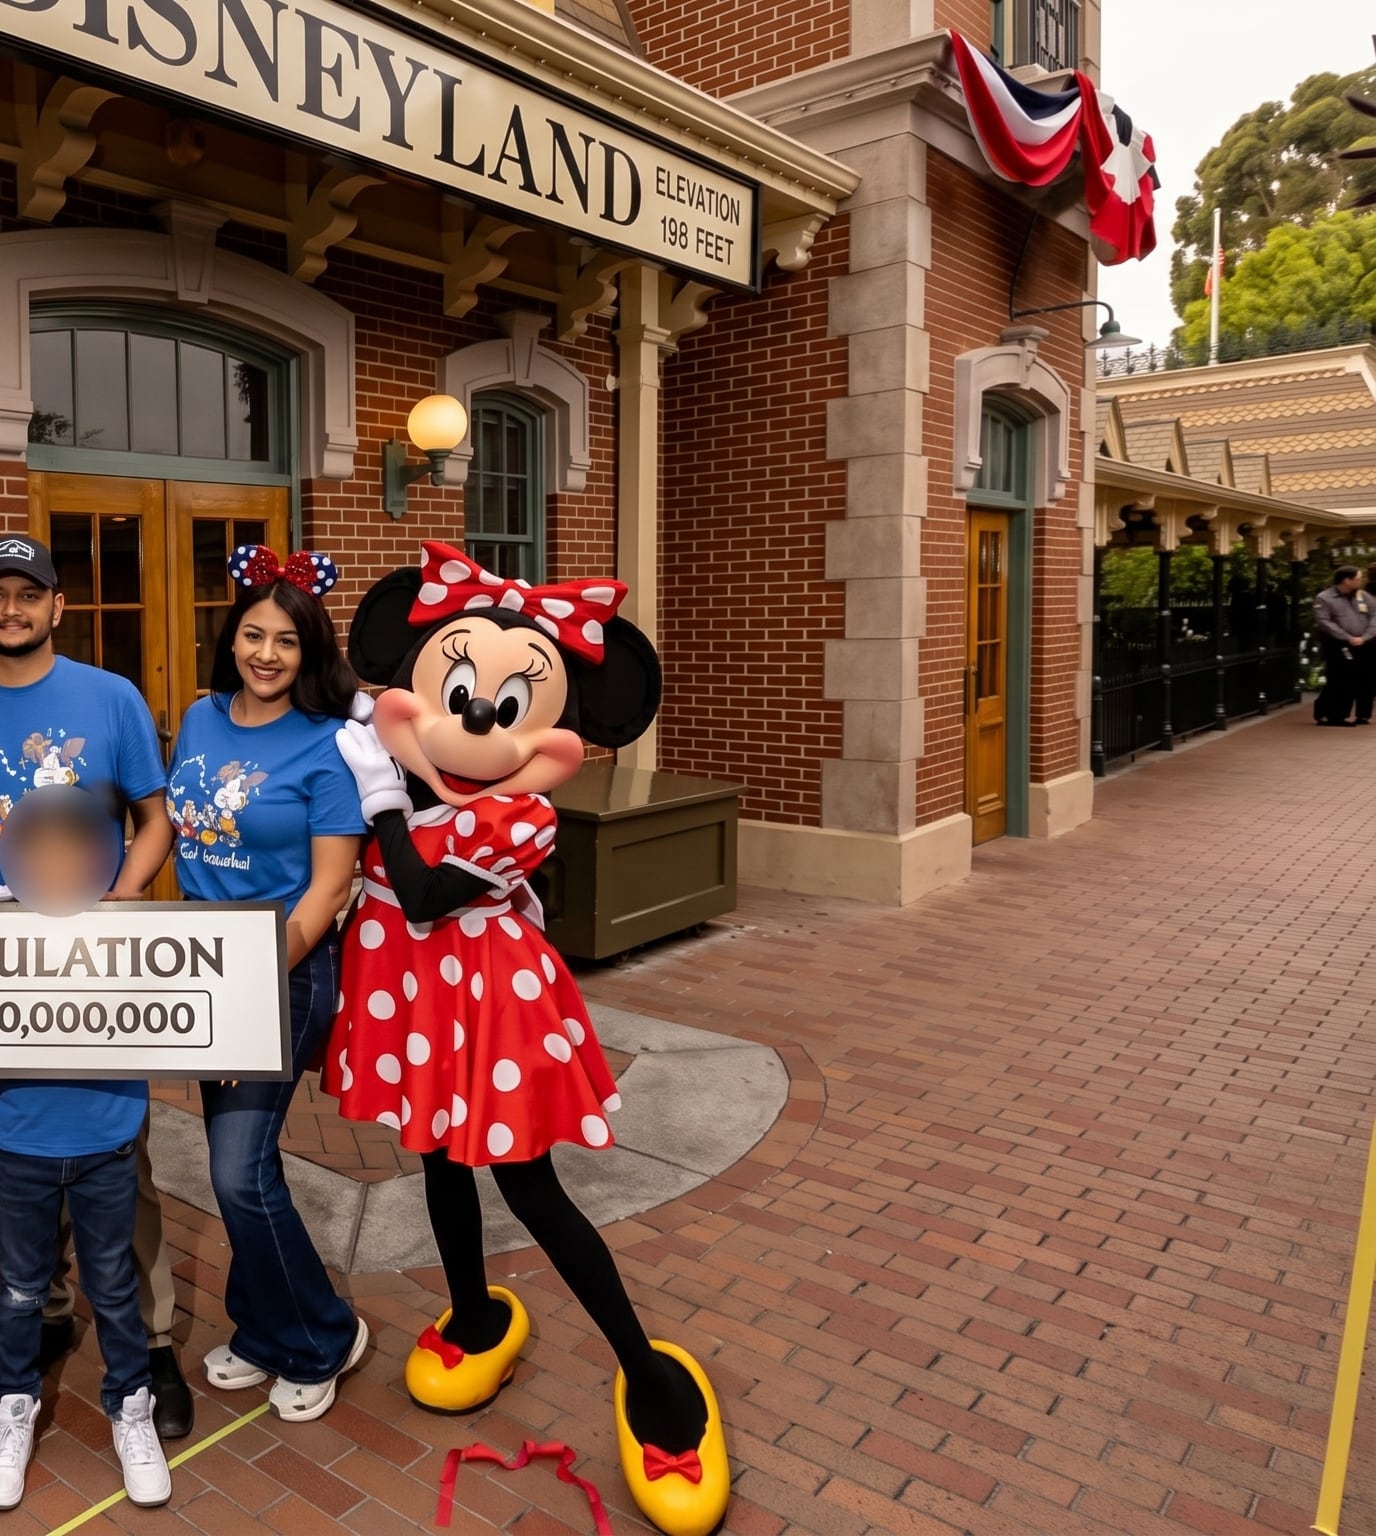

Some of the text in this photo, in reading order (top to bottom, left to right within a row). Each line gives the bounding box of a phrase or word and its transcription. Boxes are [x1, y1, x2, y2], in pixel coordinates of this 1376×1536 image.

[656, 166, 741, 226] ELEVATION
[660, 215, 734, 265] 198 FEET
